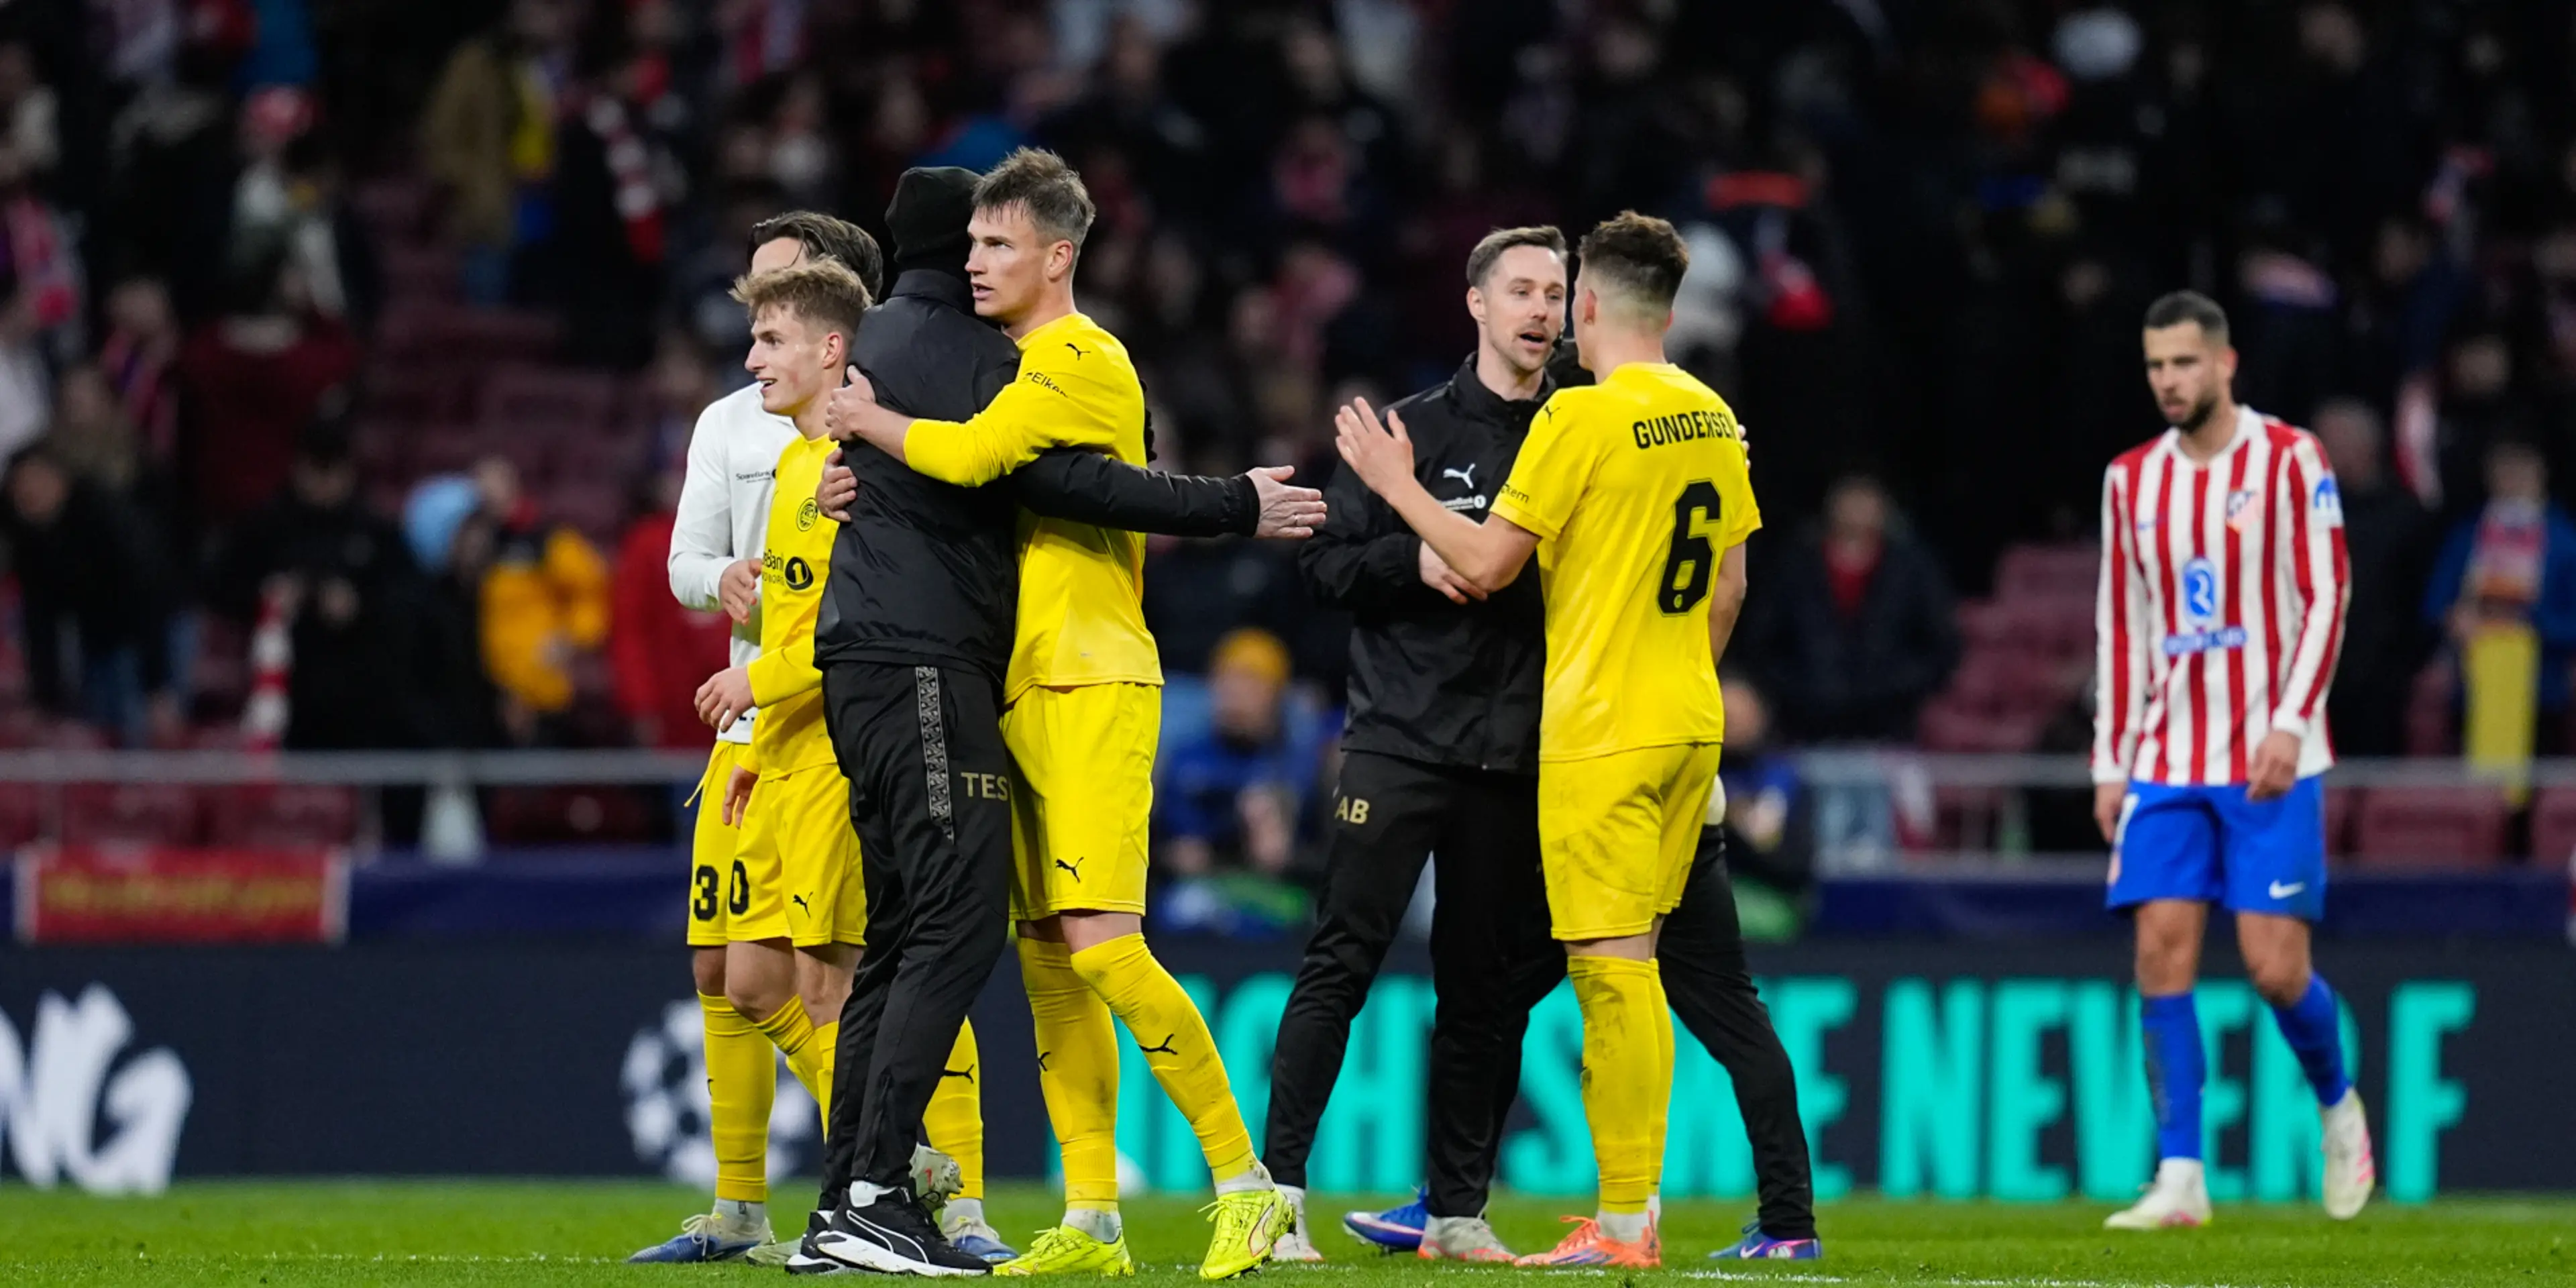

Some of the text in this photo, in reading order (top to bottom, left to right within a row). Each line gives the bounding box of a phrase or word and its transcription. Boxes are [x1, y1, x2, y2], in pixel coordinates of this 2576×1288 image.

[1032, 372, 1068, 398] Elke
[1658, 479, 1721, 616] 6
[1334, 796, 1370, 824] AB
[1882, 978, 2357, 1202] NEVER
[2388, 981, 2475, 1203] F
